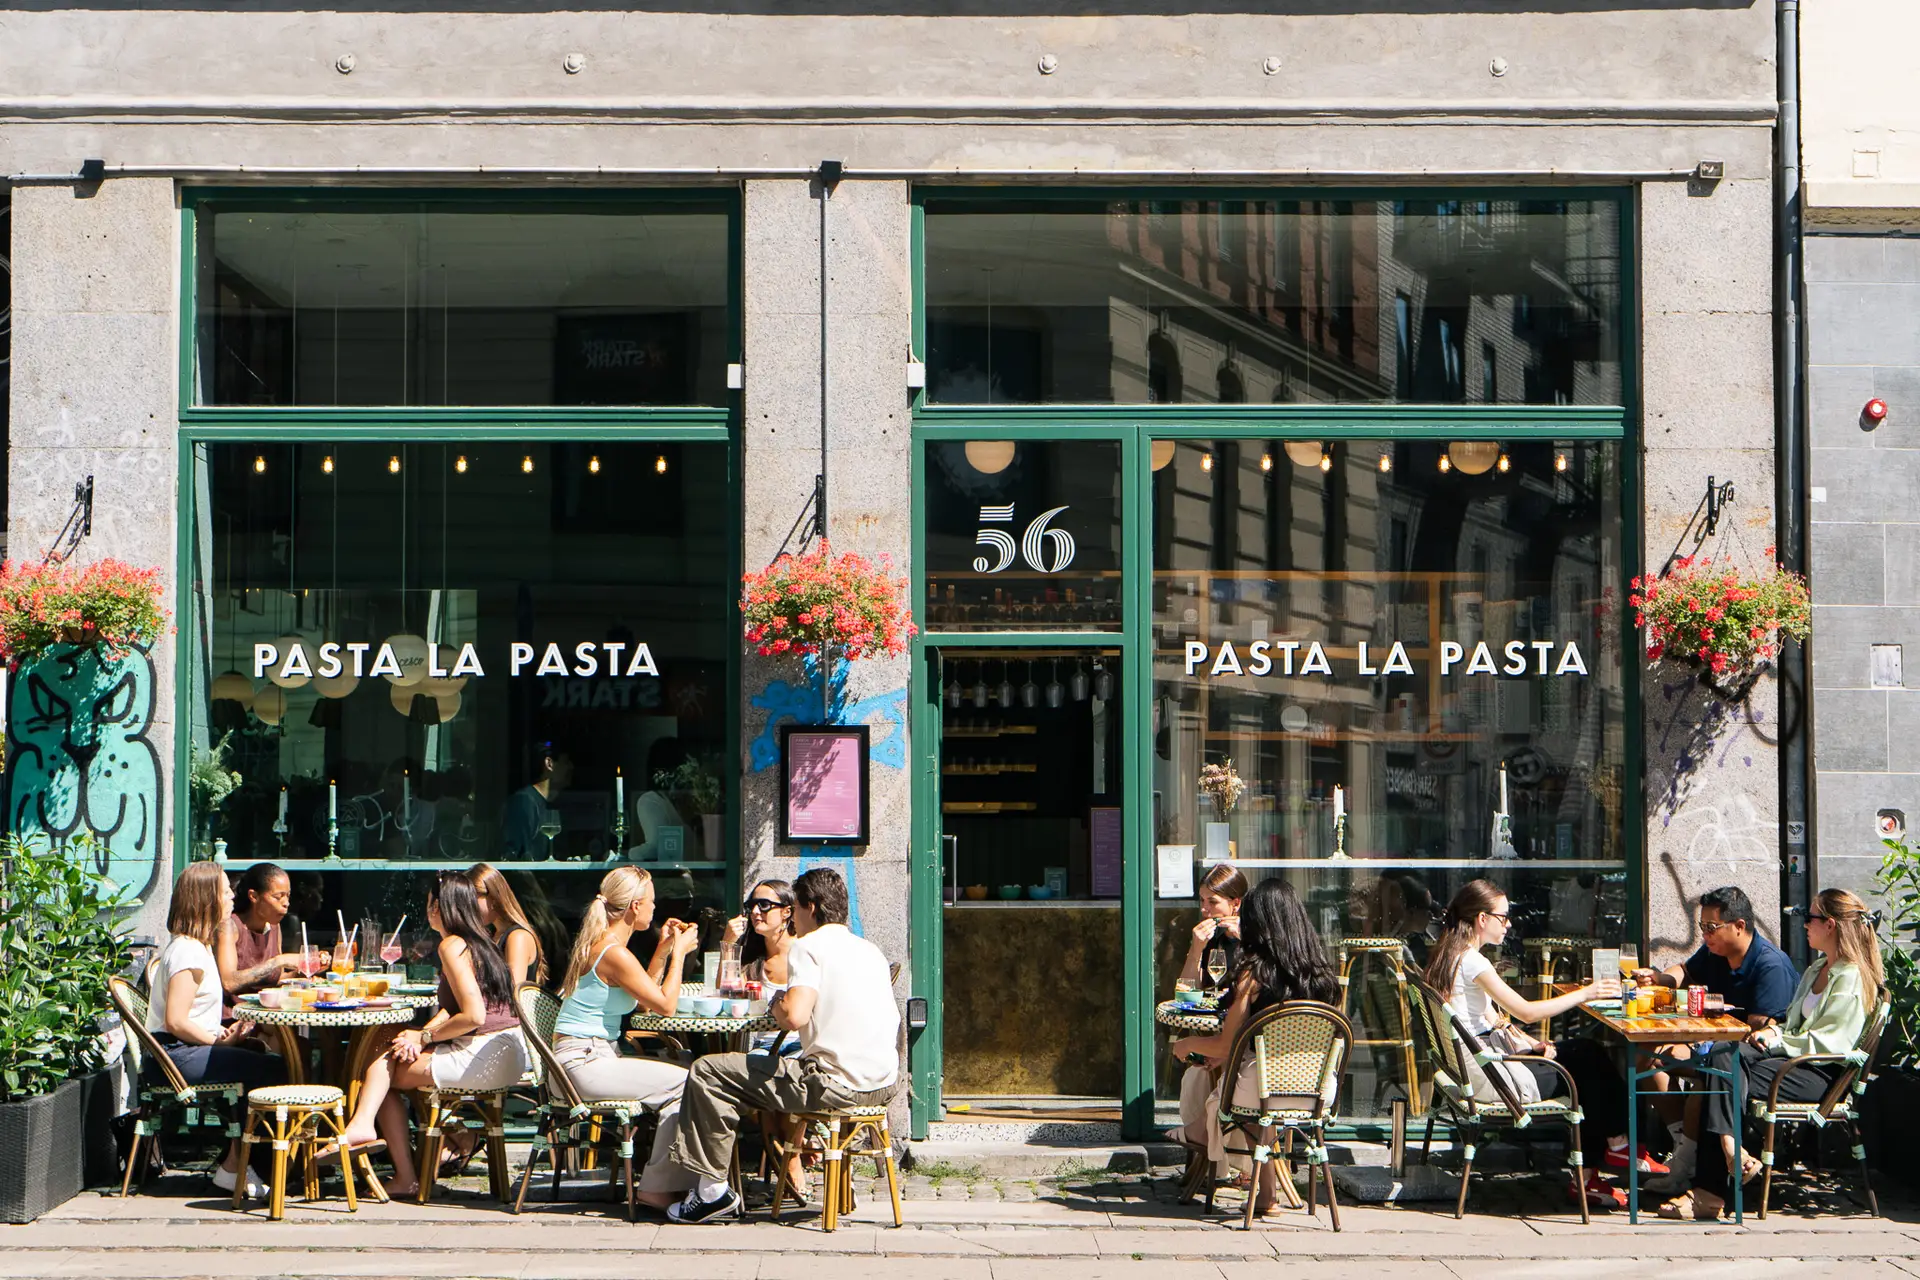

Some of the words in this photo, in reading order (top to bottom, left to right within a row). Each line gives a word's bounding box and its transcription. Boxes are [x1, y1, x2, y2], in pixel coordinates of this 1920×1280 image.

[973, 501, 1076, 574] 56
[254, 642, 402, 678] PASTA
[428, 642, 485, 677] LA
[511, 642, 659, 677] PASTA
[1185, 640, 1333, 676] PASTA
[1358, 640, 1415, 676] LA
[1440, 640, 1589, 676] PASTA
